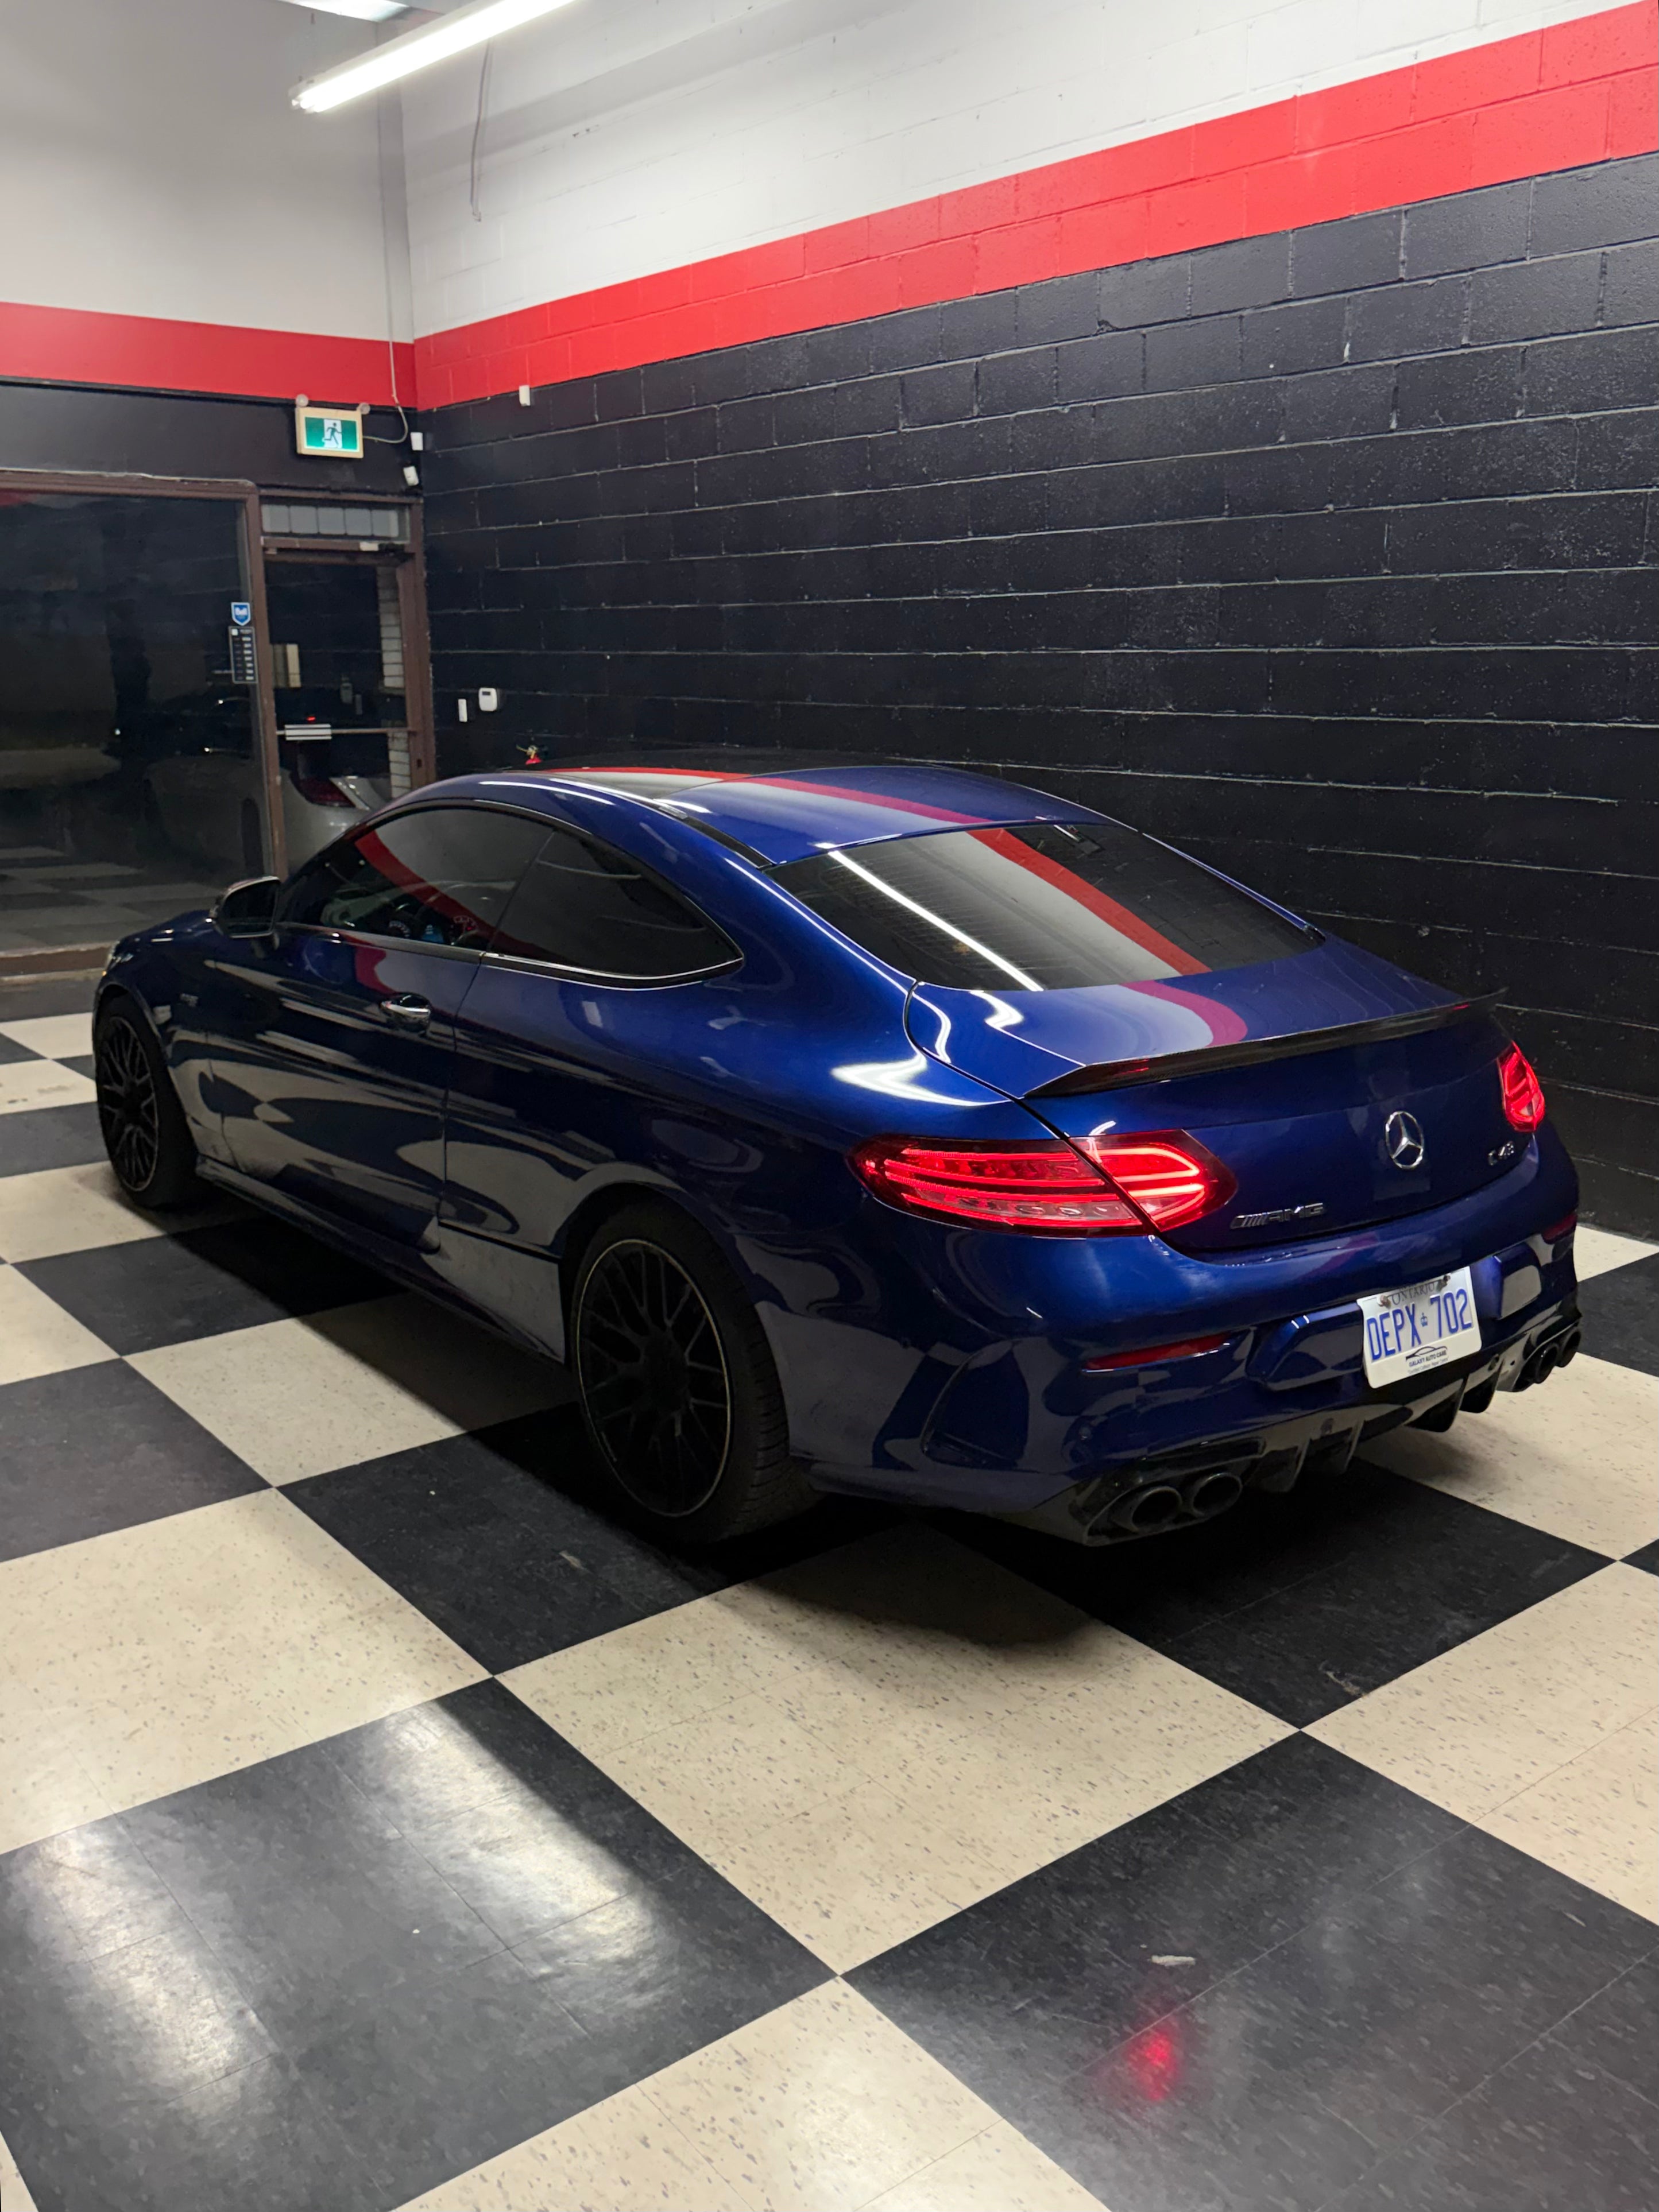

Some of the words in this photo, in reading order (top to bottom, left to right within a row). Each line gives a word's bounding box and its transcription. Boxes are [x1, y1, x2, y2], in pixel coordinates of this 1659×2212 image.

[1391, 1282, 1435, 1305] ONTARIO
[1366, 1303, 1421, 1361] DEPX
[1430, 1289, 1472, 1338] 702
[1409, 1357, 1425, 1367] GALAXY
